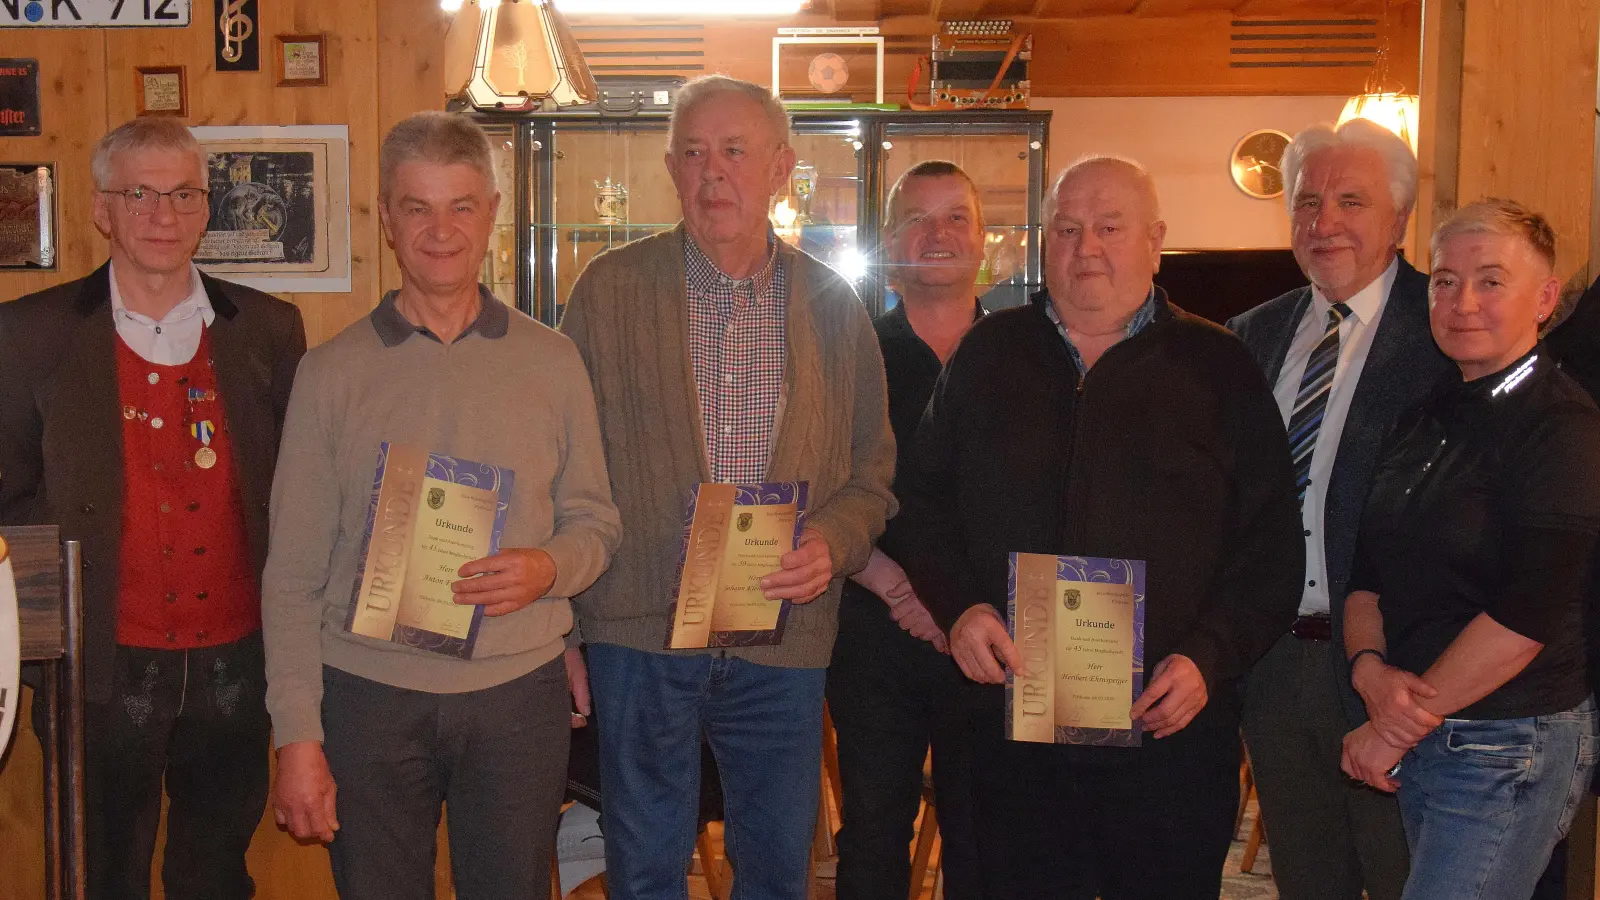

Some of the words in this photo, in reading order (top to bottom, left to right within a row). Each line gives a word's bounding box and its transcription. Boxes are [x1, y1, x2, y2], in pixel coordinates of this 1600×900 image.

[365, 481, 416, 613] URKUNDE
[435, 518, 474, 534] Urkunde
[745, 538, 779, 546] Urkunde
[683, 513, 724, 627] URKUNDE
[1022, 586, 1048, 717] URKUNDE
[1075, 618, 1115, 630] Urkunde
